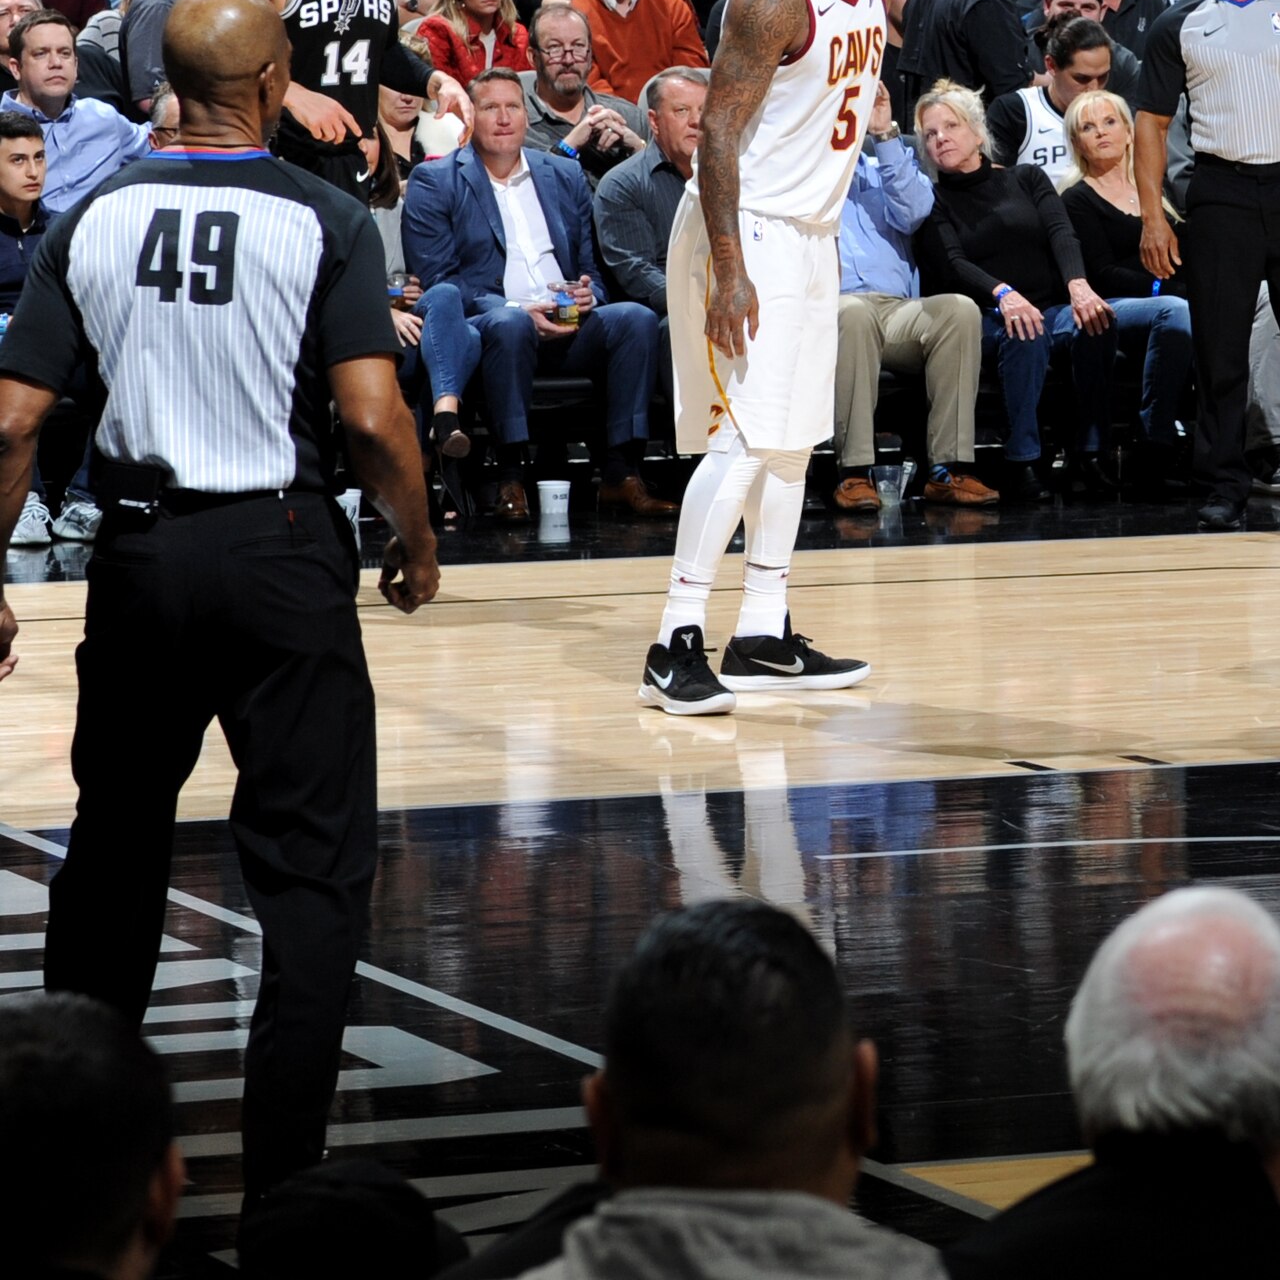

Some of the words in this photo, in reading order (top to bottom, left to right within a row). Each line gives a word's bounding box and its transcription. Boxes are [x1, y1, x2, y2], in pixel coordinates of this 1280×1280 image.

[321, 39, 370, 87] 14
[829, 24, 884, 87] CAVS
[829, 84, 859, 152] 5
